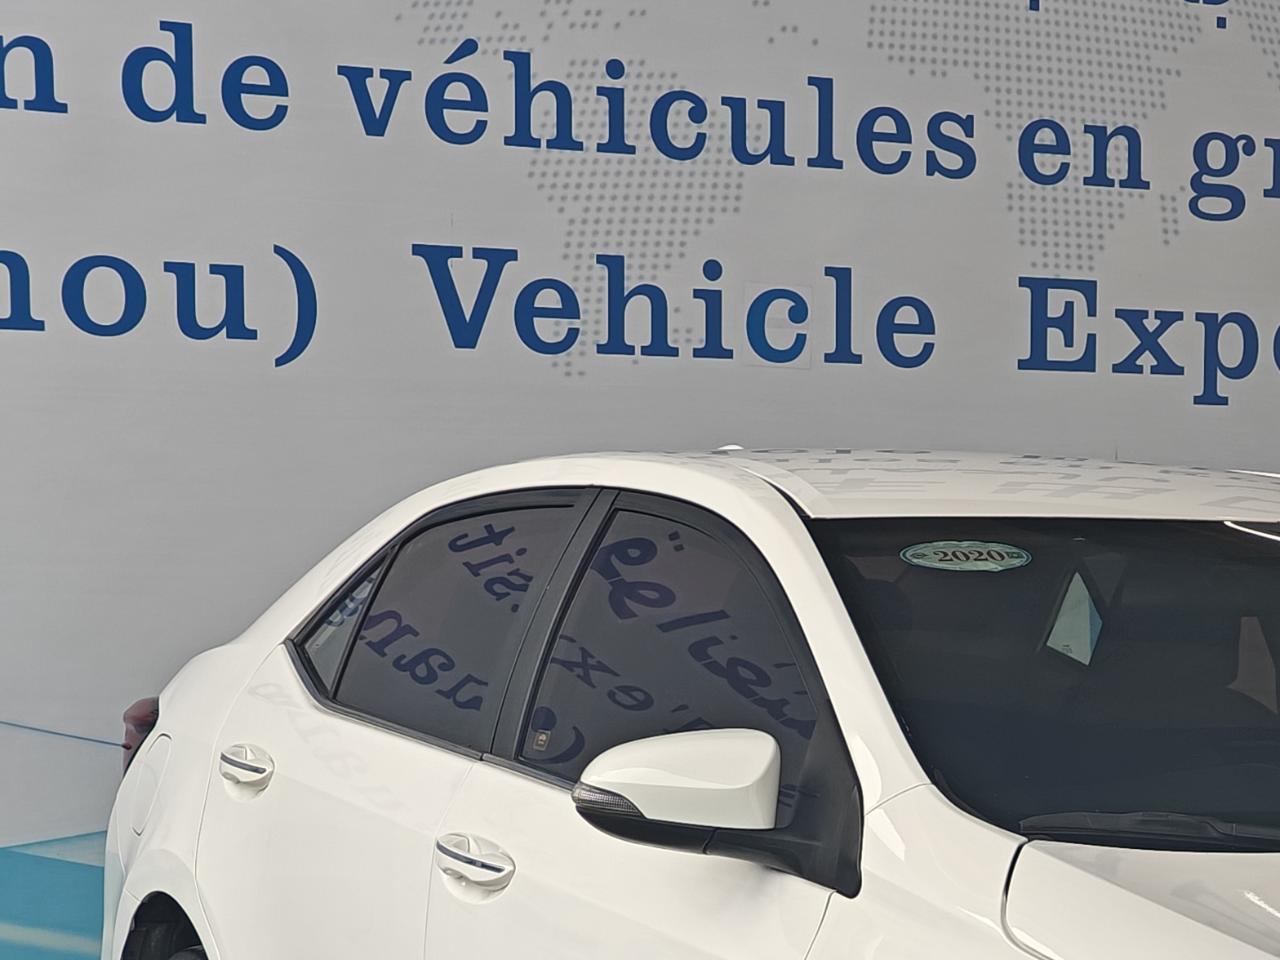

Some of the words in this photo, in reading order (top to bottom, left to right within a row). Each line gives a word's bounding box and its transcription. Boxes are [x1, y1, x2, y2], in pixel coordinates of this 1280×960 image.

[120, 20, 289, 132] de
[336, 38, 977, 180] véhicules
[1018, 118, 1151, 190] en
[411, 243, 936, 369] Vehicle
[933, 549, 1006, 562] 2020
